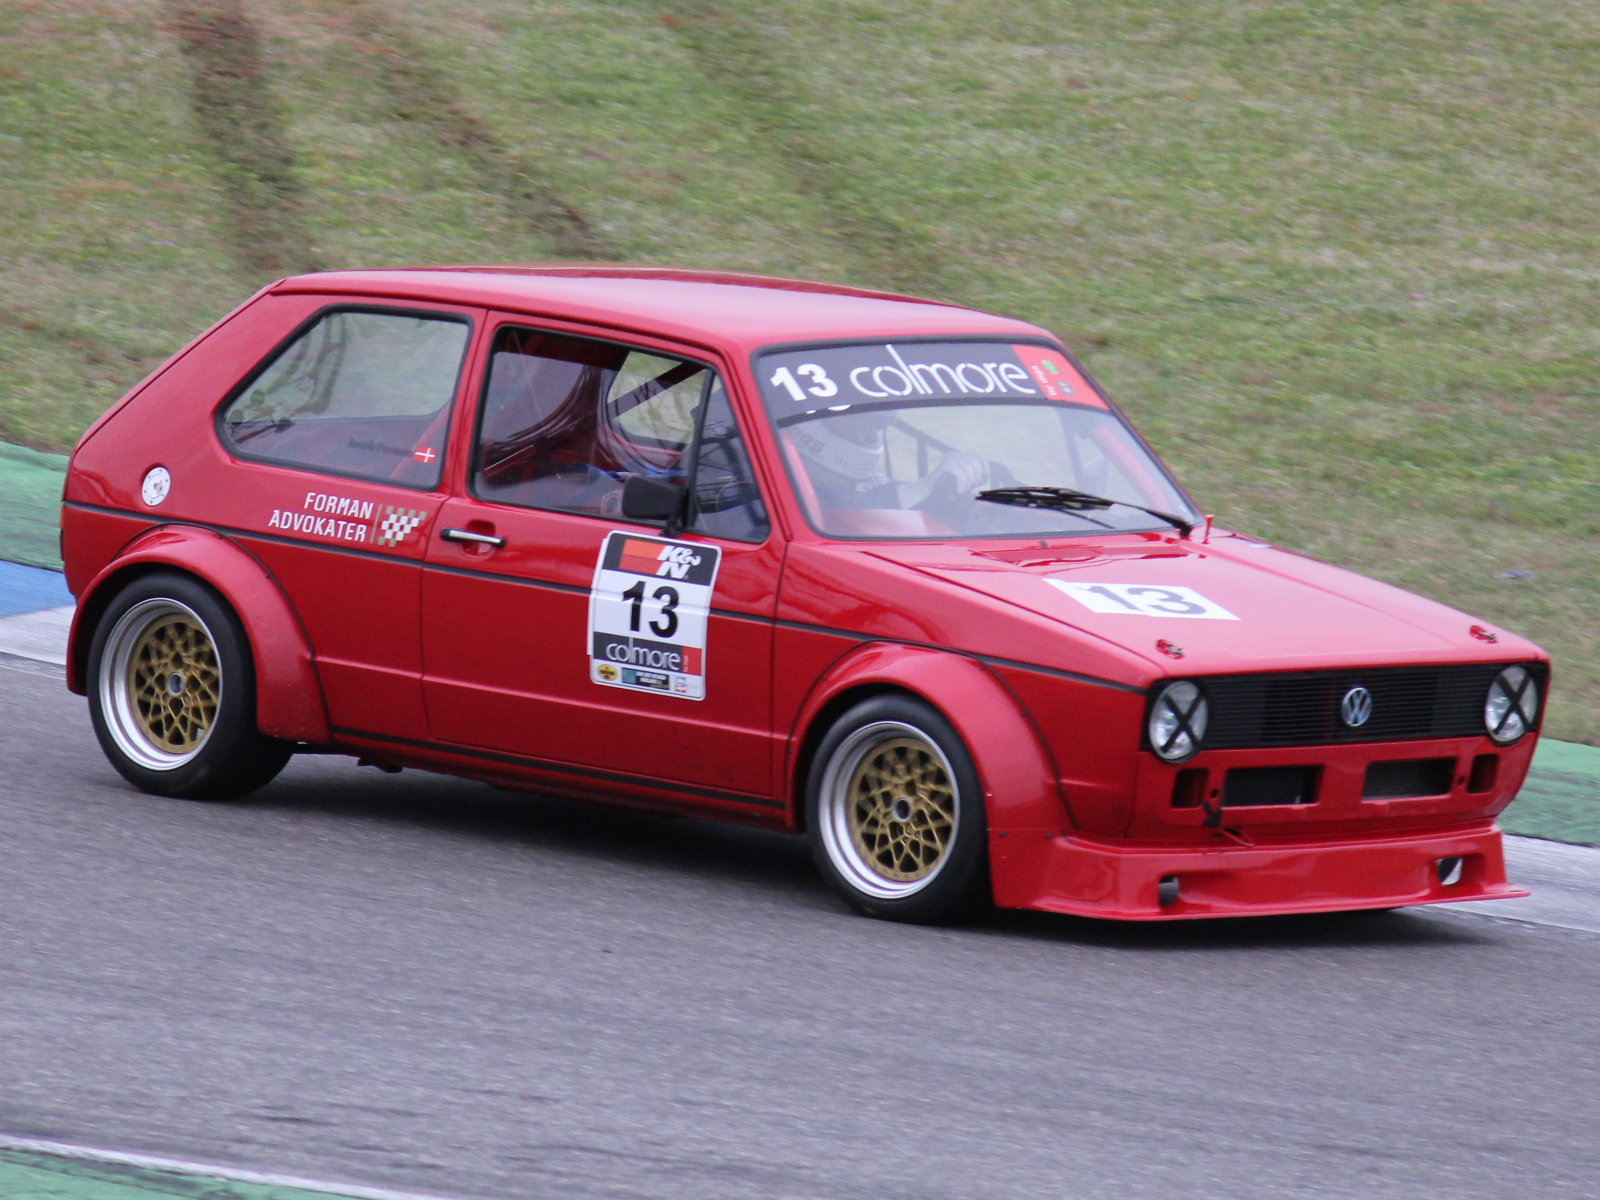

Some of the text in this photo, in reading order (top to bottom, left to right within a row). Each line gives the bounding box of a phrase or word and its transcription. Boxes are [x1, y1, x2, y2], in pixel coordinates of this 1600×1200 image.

[770, 363, 838, 401] 13
[850, 344, 1036, 397] colmore
[304, 492, 374, 519] FORMAN
[268, 510, 367, 542] ADVOKATER
[622, 580, 678, 638] 13
[1075, 586, 1206, 614] 13
[606, 637, 681, 670] colmore
